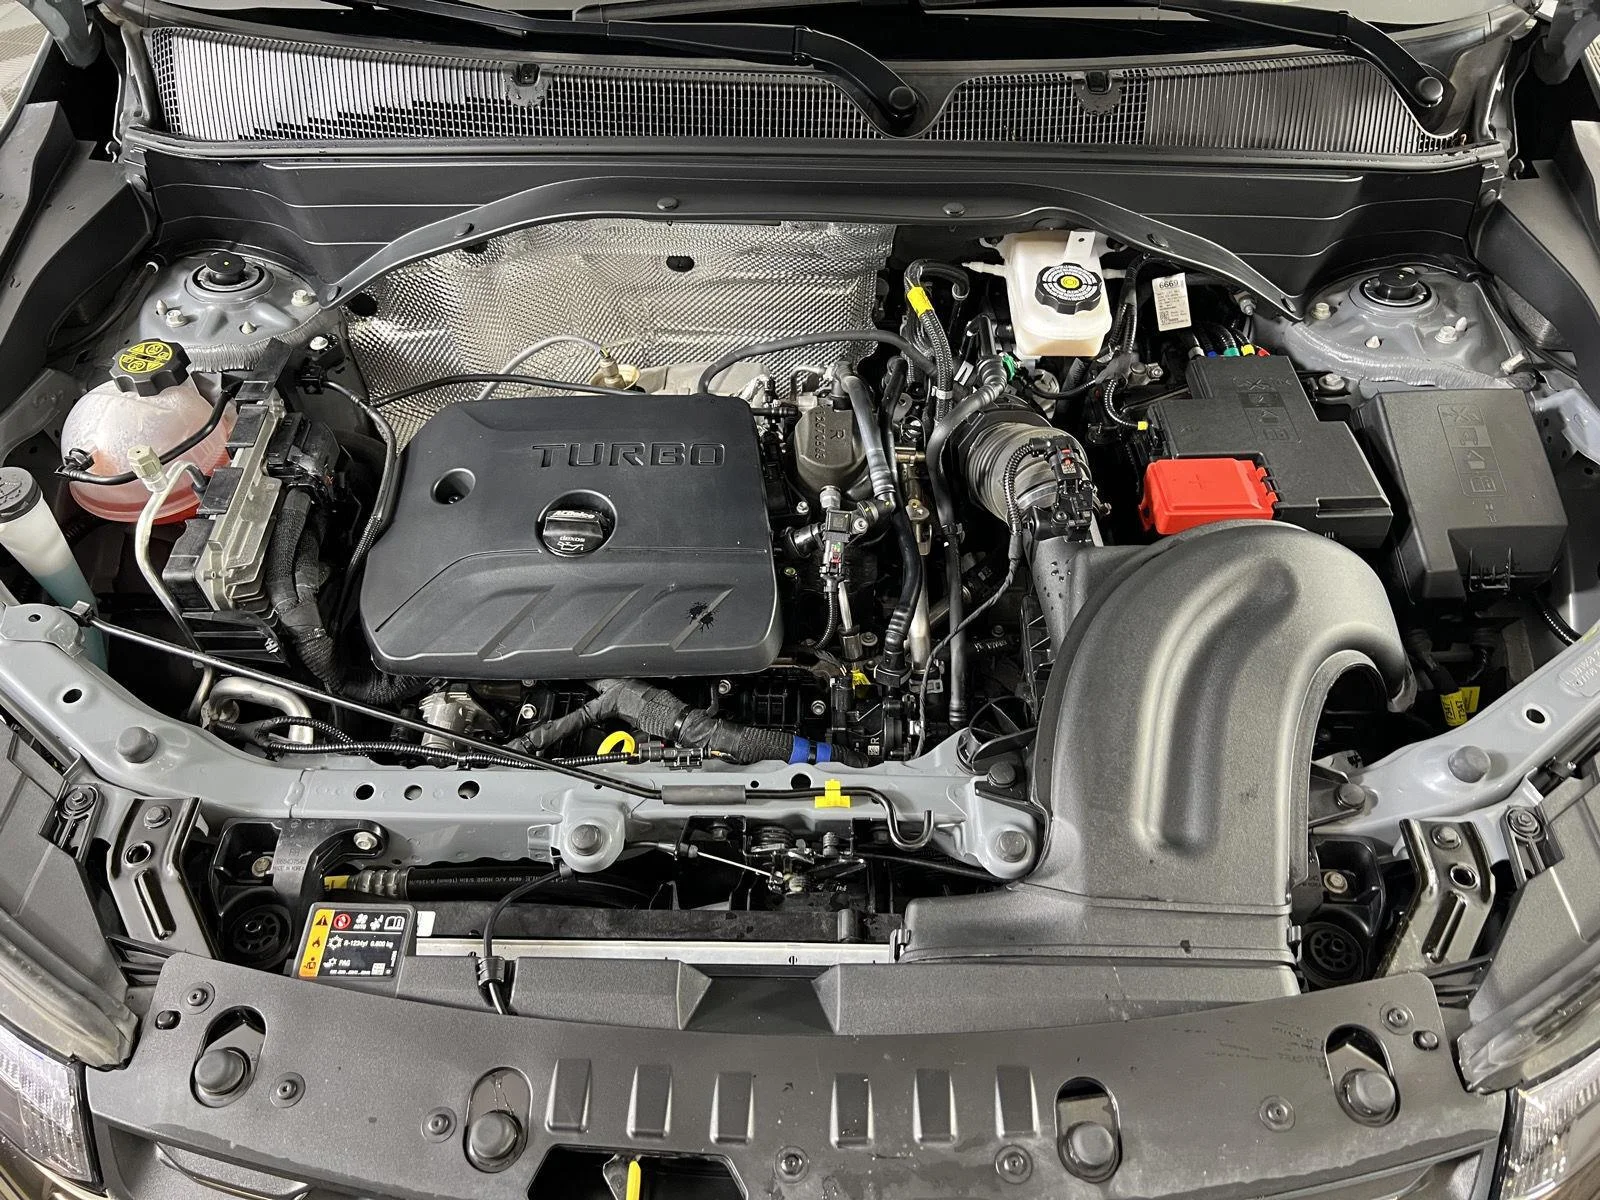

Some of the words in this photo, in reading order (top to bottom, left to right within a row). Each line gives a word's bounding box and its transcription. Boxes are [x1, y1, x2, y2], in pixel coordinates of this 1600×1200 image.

[1159, 280, 1179, 289] 6669
[830, 429, 846, 440] R
[532, 442, 726, 468] TURBO
[559, 535, 586, 543] dexos
[1455, 700, 1465, 720] 7347
[386, 940, 394, 949] kg
